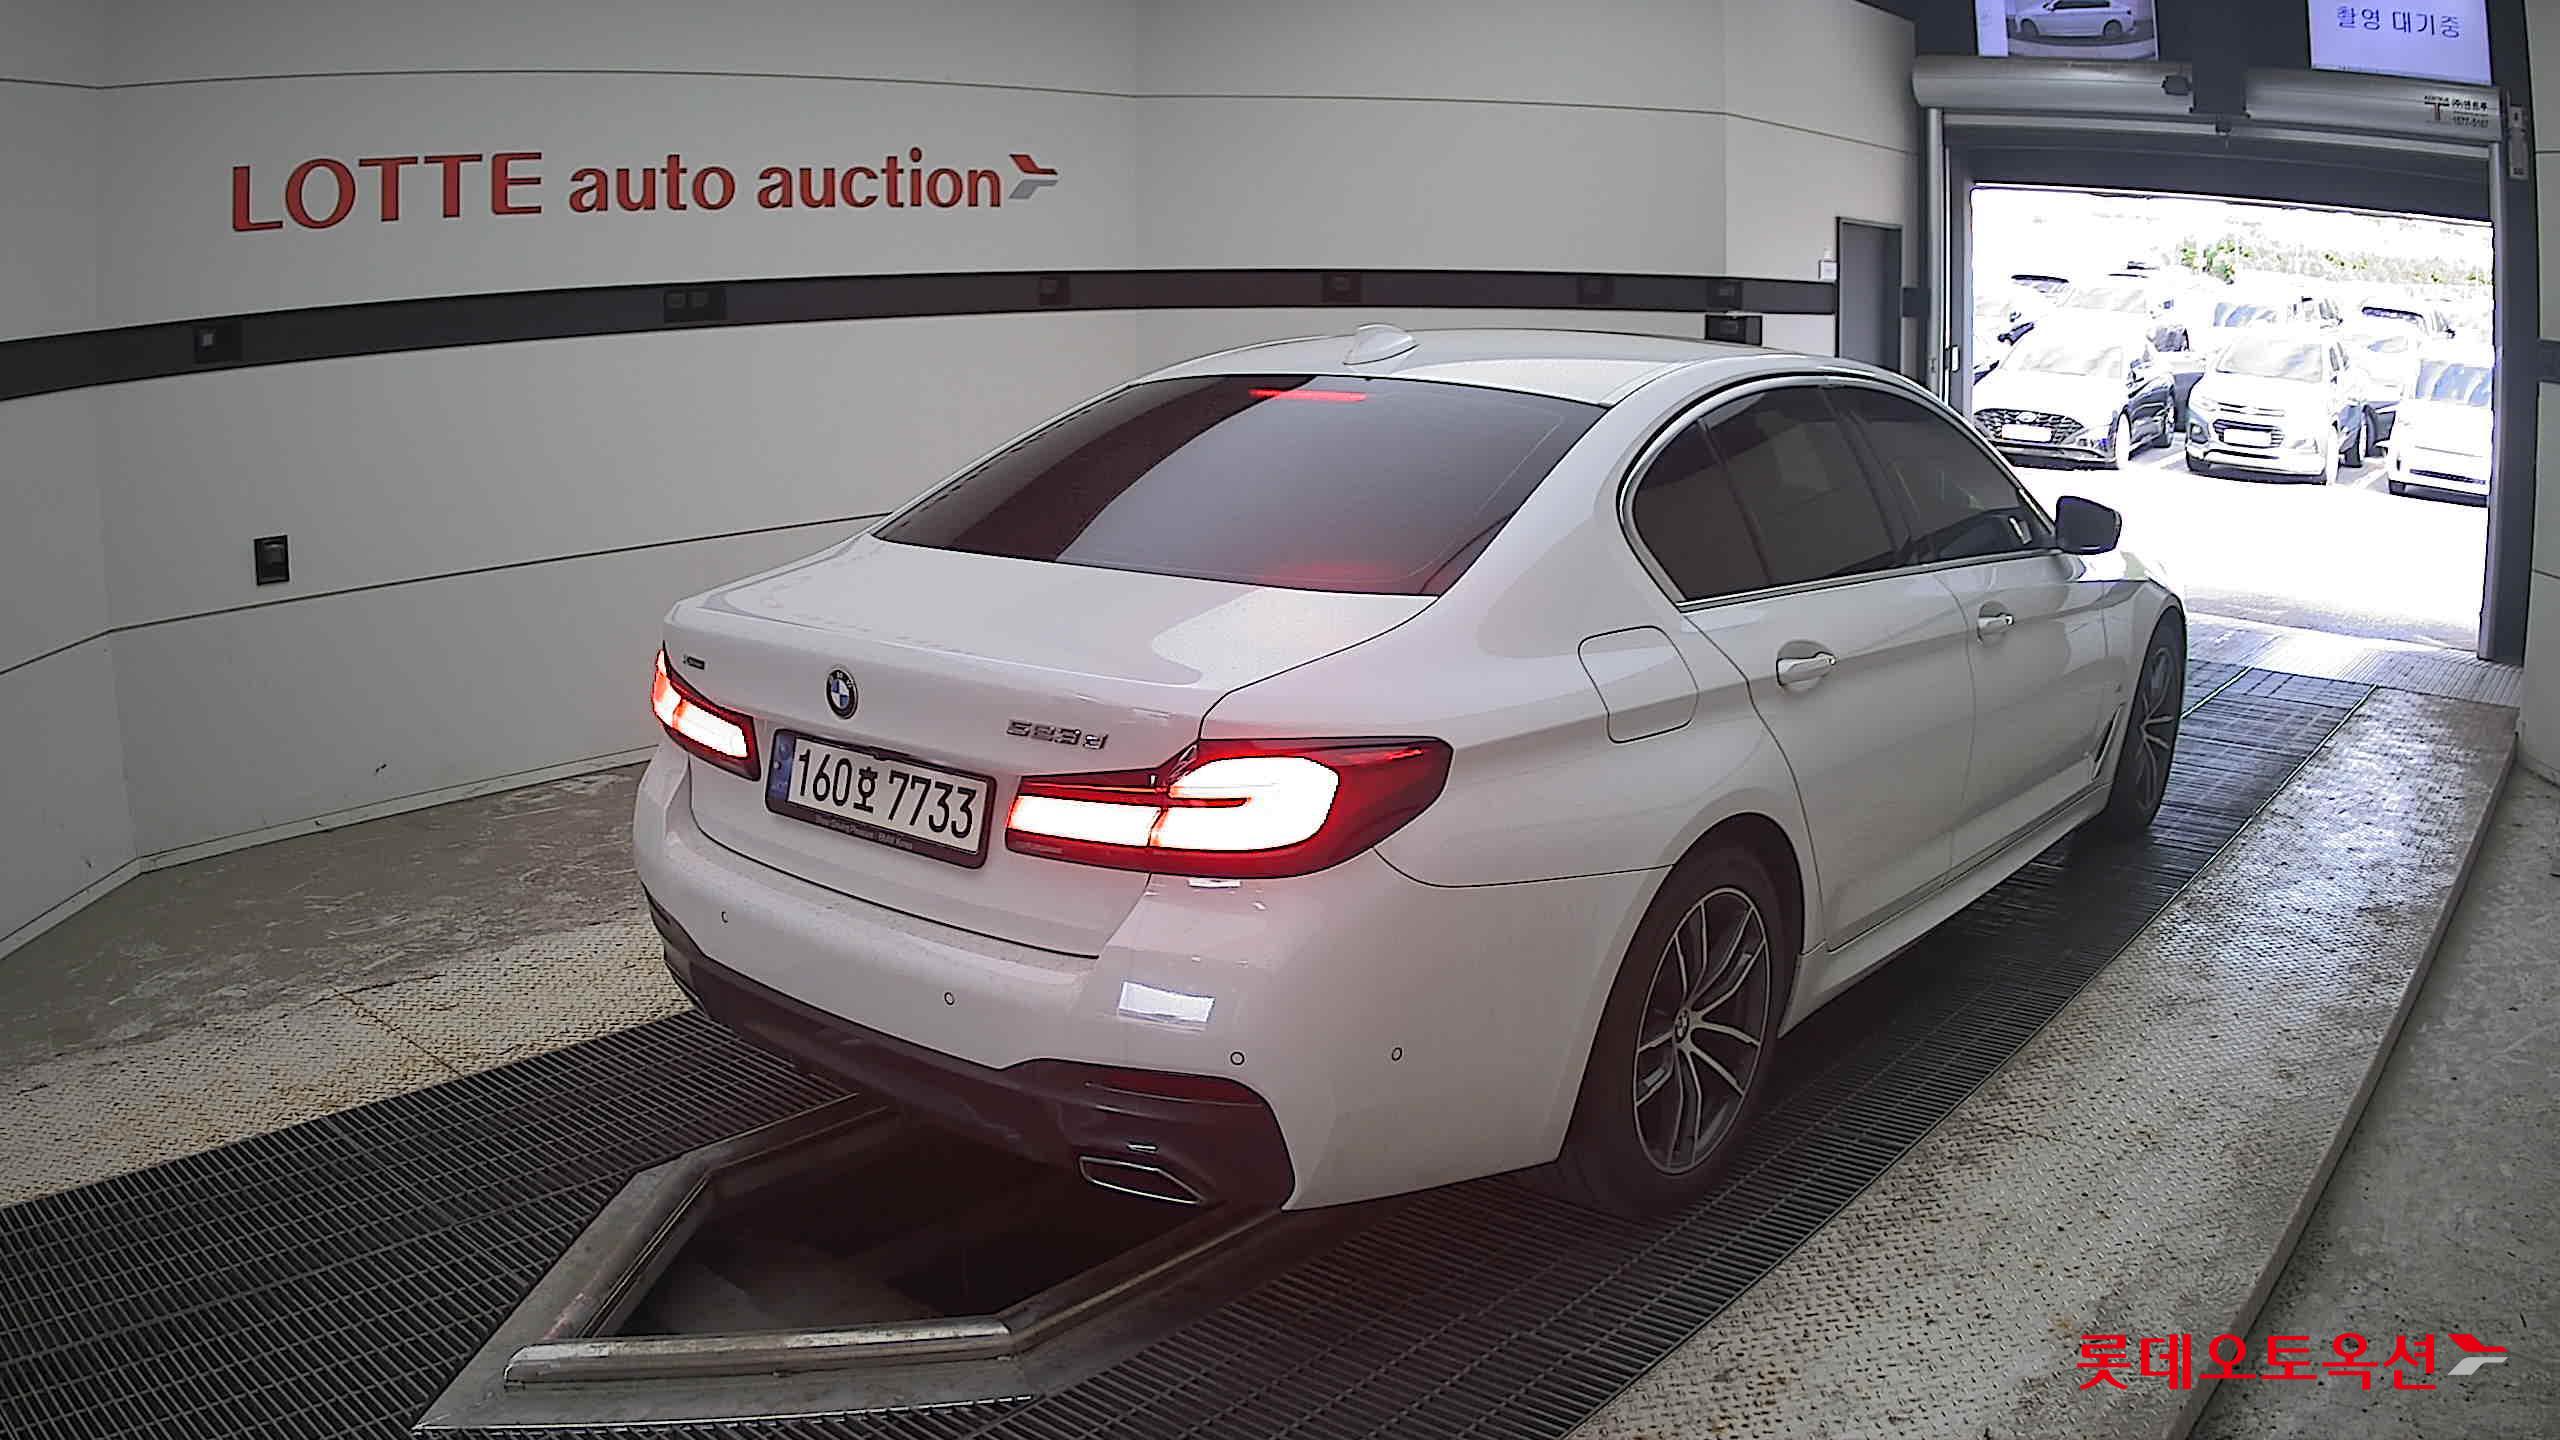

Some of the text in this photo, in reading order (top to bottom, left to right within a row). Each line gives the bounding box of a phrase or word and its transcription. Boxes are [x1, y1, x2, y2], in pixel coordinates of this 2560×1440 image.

[2337, 5, 2460, 39] 촬영 대기중
[231, 146, 1001, 232] LOTTE auto auction
[798, 748, 879, 814] 160호
[888, 769, 977, 839] 7733
